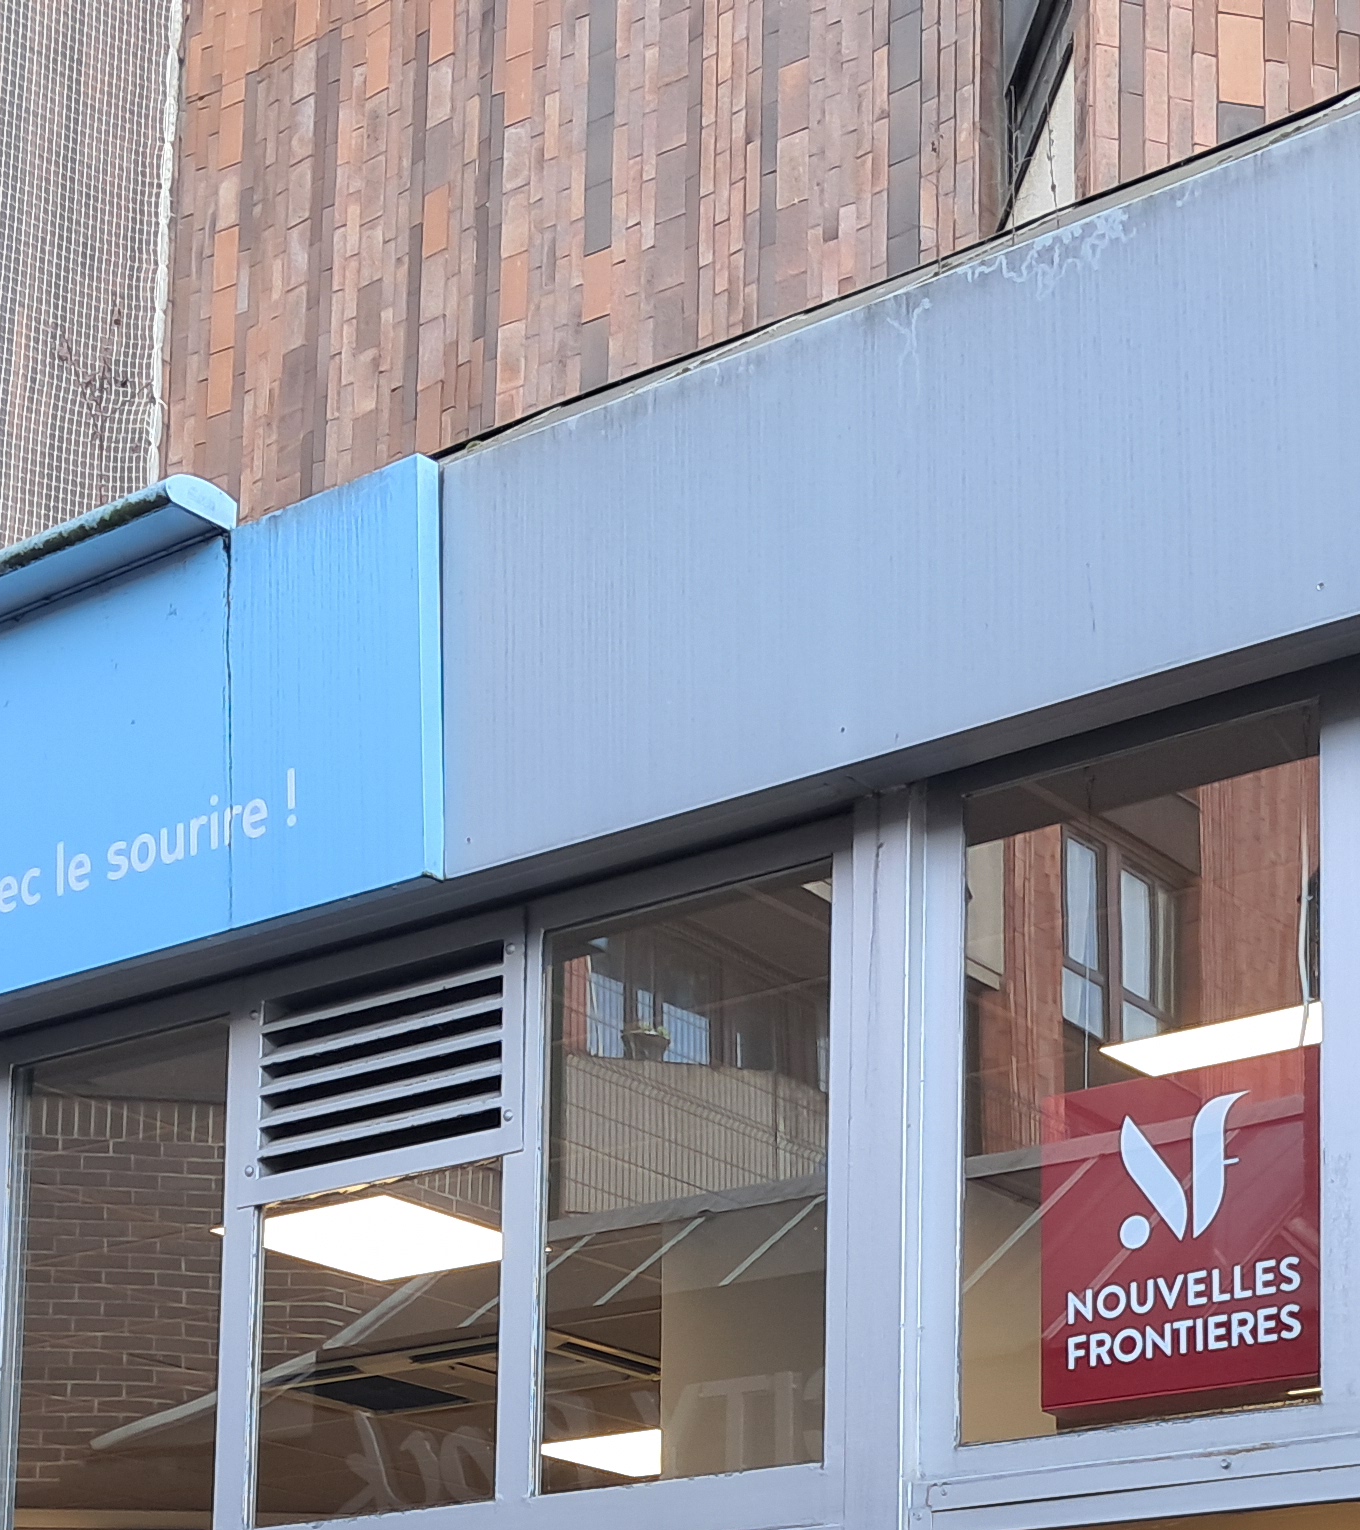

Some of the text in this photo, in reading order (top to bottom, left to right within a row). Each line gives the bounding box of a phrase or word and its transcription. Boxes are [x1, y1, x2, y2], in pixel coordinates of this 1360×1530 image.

[55, 841, 91, 895] le
[106, 794, 268, 882] sourire
[1067, 1256, 1300, 1325] NOUVELLES
[1067, 1304, 1302, 1370] FRONTIERES
